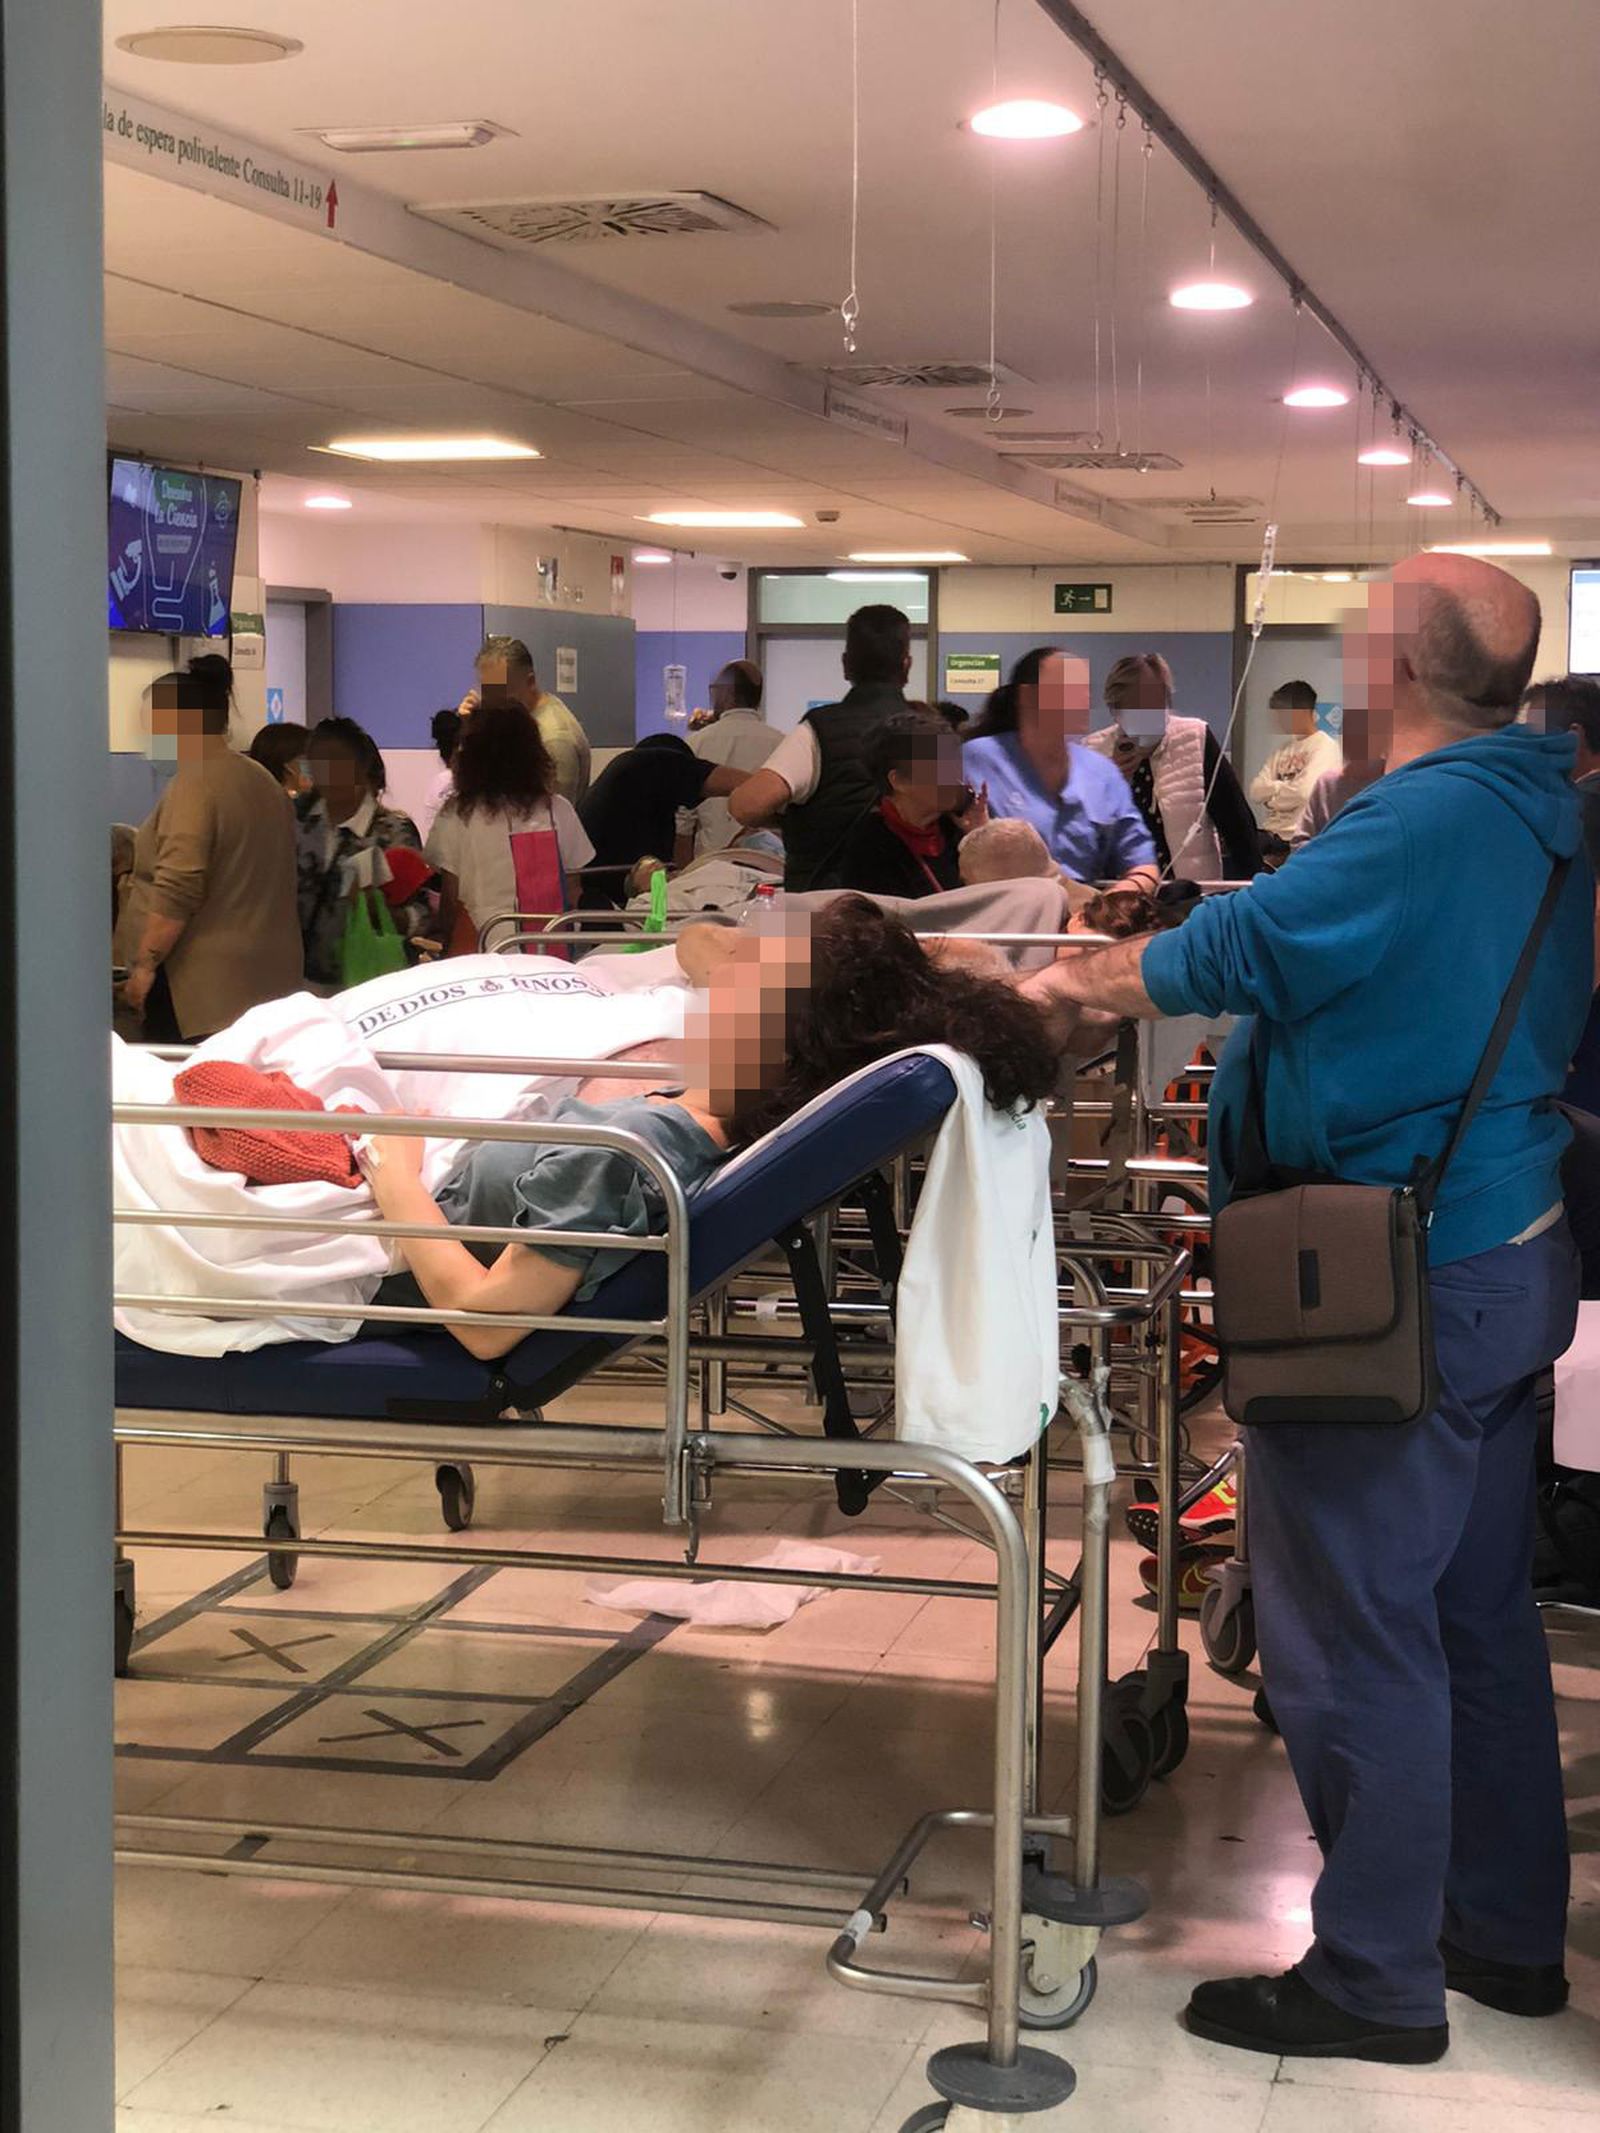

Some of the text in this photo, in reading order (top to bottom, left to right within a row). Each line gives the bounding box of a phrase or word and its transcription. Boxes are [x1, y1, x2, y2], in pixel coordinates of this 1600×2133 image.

[118, 110, 133, 138] de
[136, 124, 175, 154] espera
[178, 136, 240, 178] polivalente
[243, 158, 290, 198] Consulta
[294, 178, 322, 209] 11-19
[358, 1006, 397, 1033] DE
[398, 984, 467, 1014] DIOS
